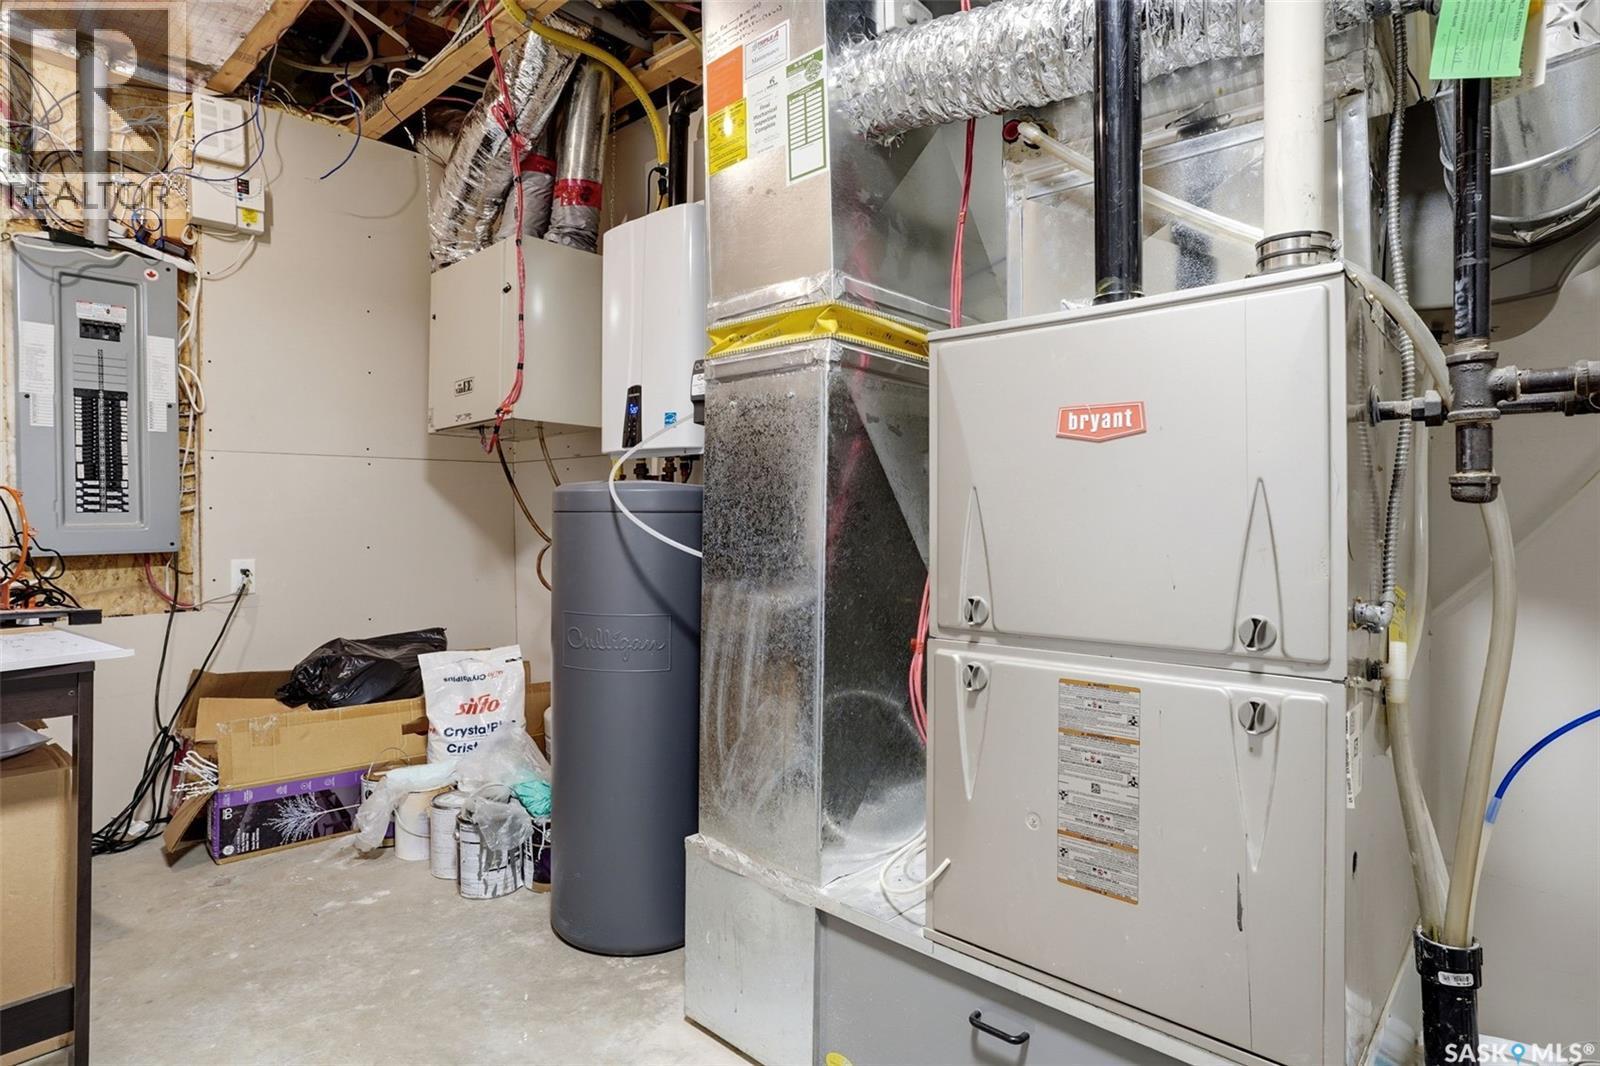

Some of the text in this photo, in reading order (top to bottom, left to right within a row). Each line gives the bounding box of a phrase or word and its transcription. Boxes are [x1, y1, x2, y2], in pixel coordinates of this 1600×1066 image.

[1068, 408, 1132, 432] bryant
[568, 626, 665, 661] Culligan
[444, 720, 516, 738] CrystalP
